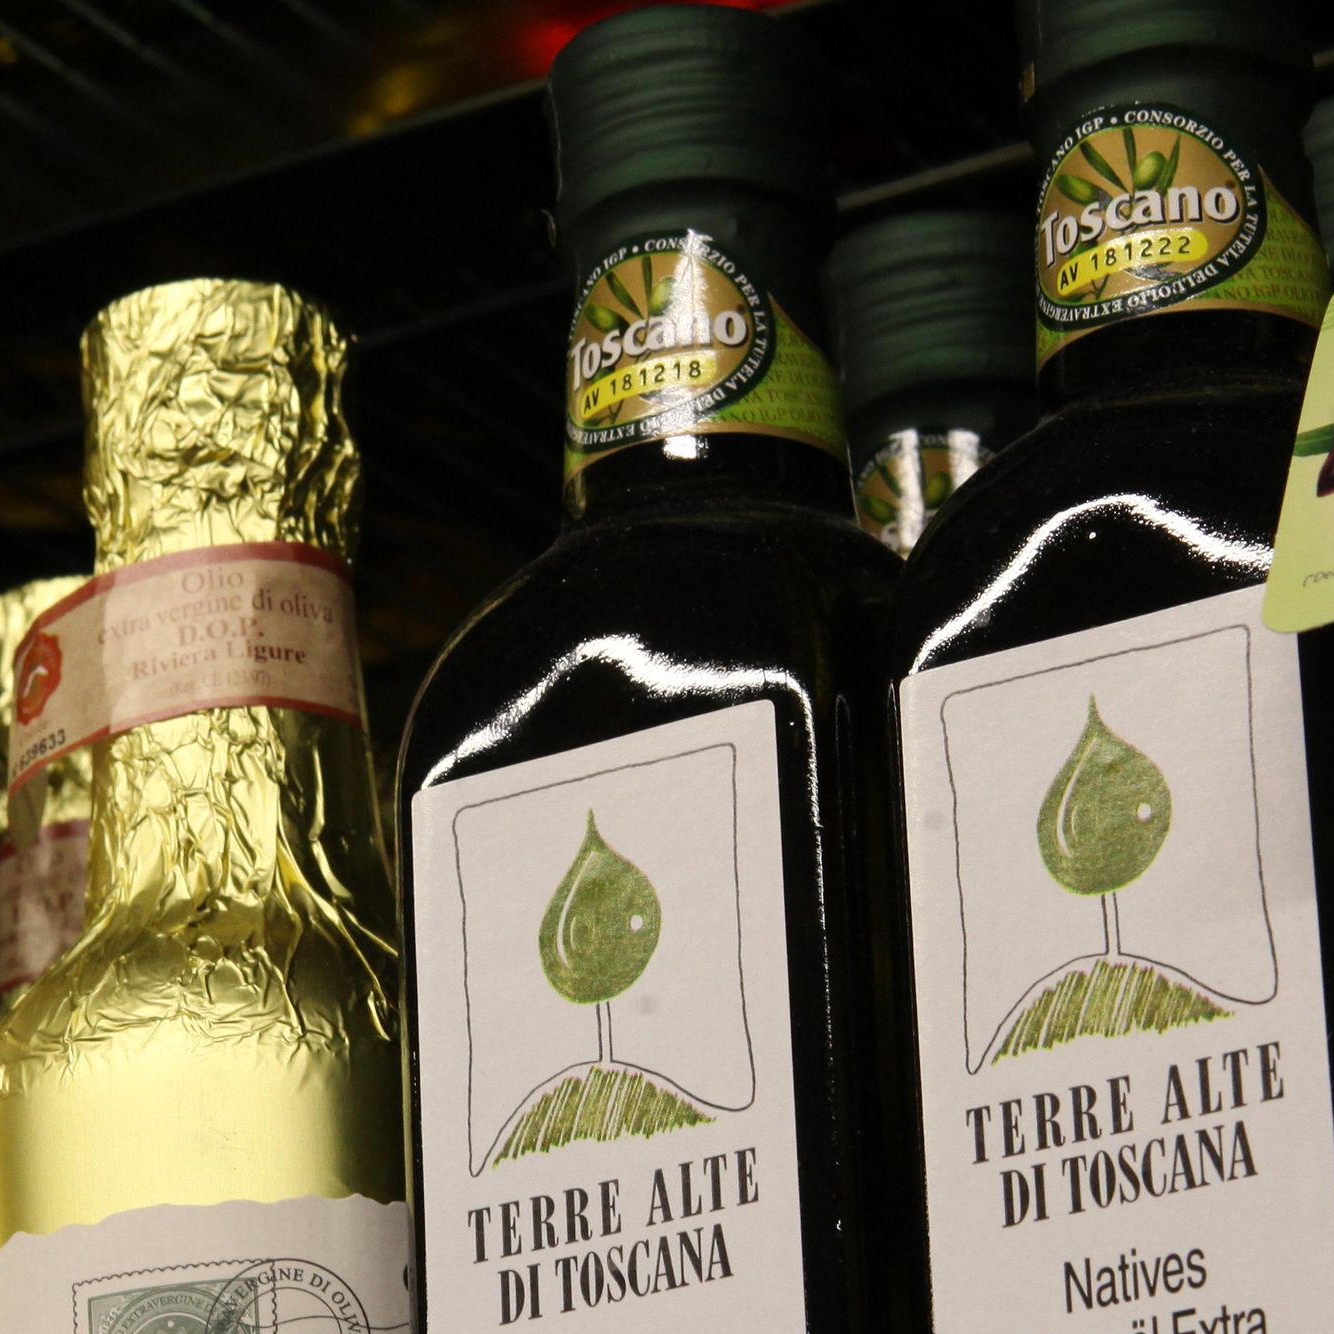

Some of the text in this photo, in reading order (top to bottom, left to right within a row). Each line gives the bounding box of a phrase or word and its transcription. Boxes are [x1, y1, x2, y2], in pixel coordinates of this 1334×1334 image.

[1040, 185, 1241, 267] Toscano
[1060, 236, 1191, 289] AV 181222
[571, 310, 748, 393] Toscano
[610, 360, 702, 396] 181218
[966, 1040, 1285, 1166] TERRE ALTE
[467, 1146, 759, 1264] TERRE ALTE
[1001, 1120, 1257, 1229] DI TOSCANA
[497, 1222, 734, 1326] DI TOSCANA
[1064, 1248, 1207, 1314] Natives
